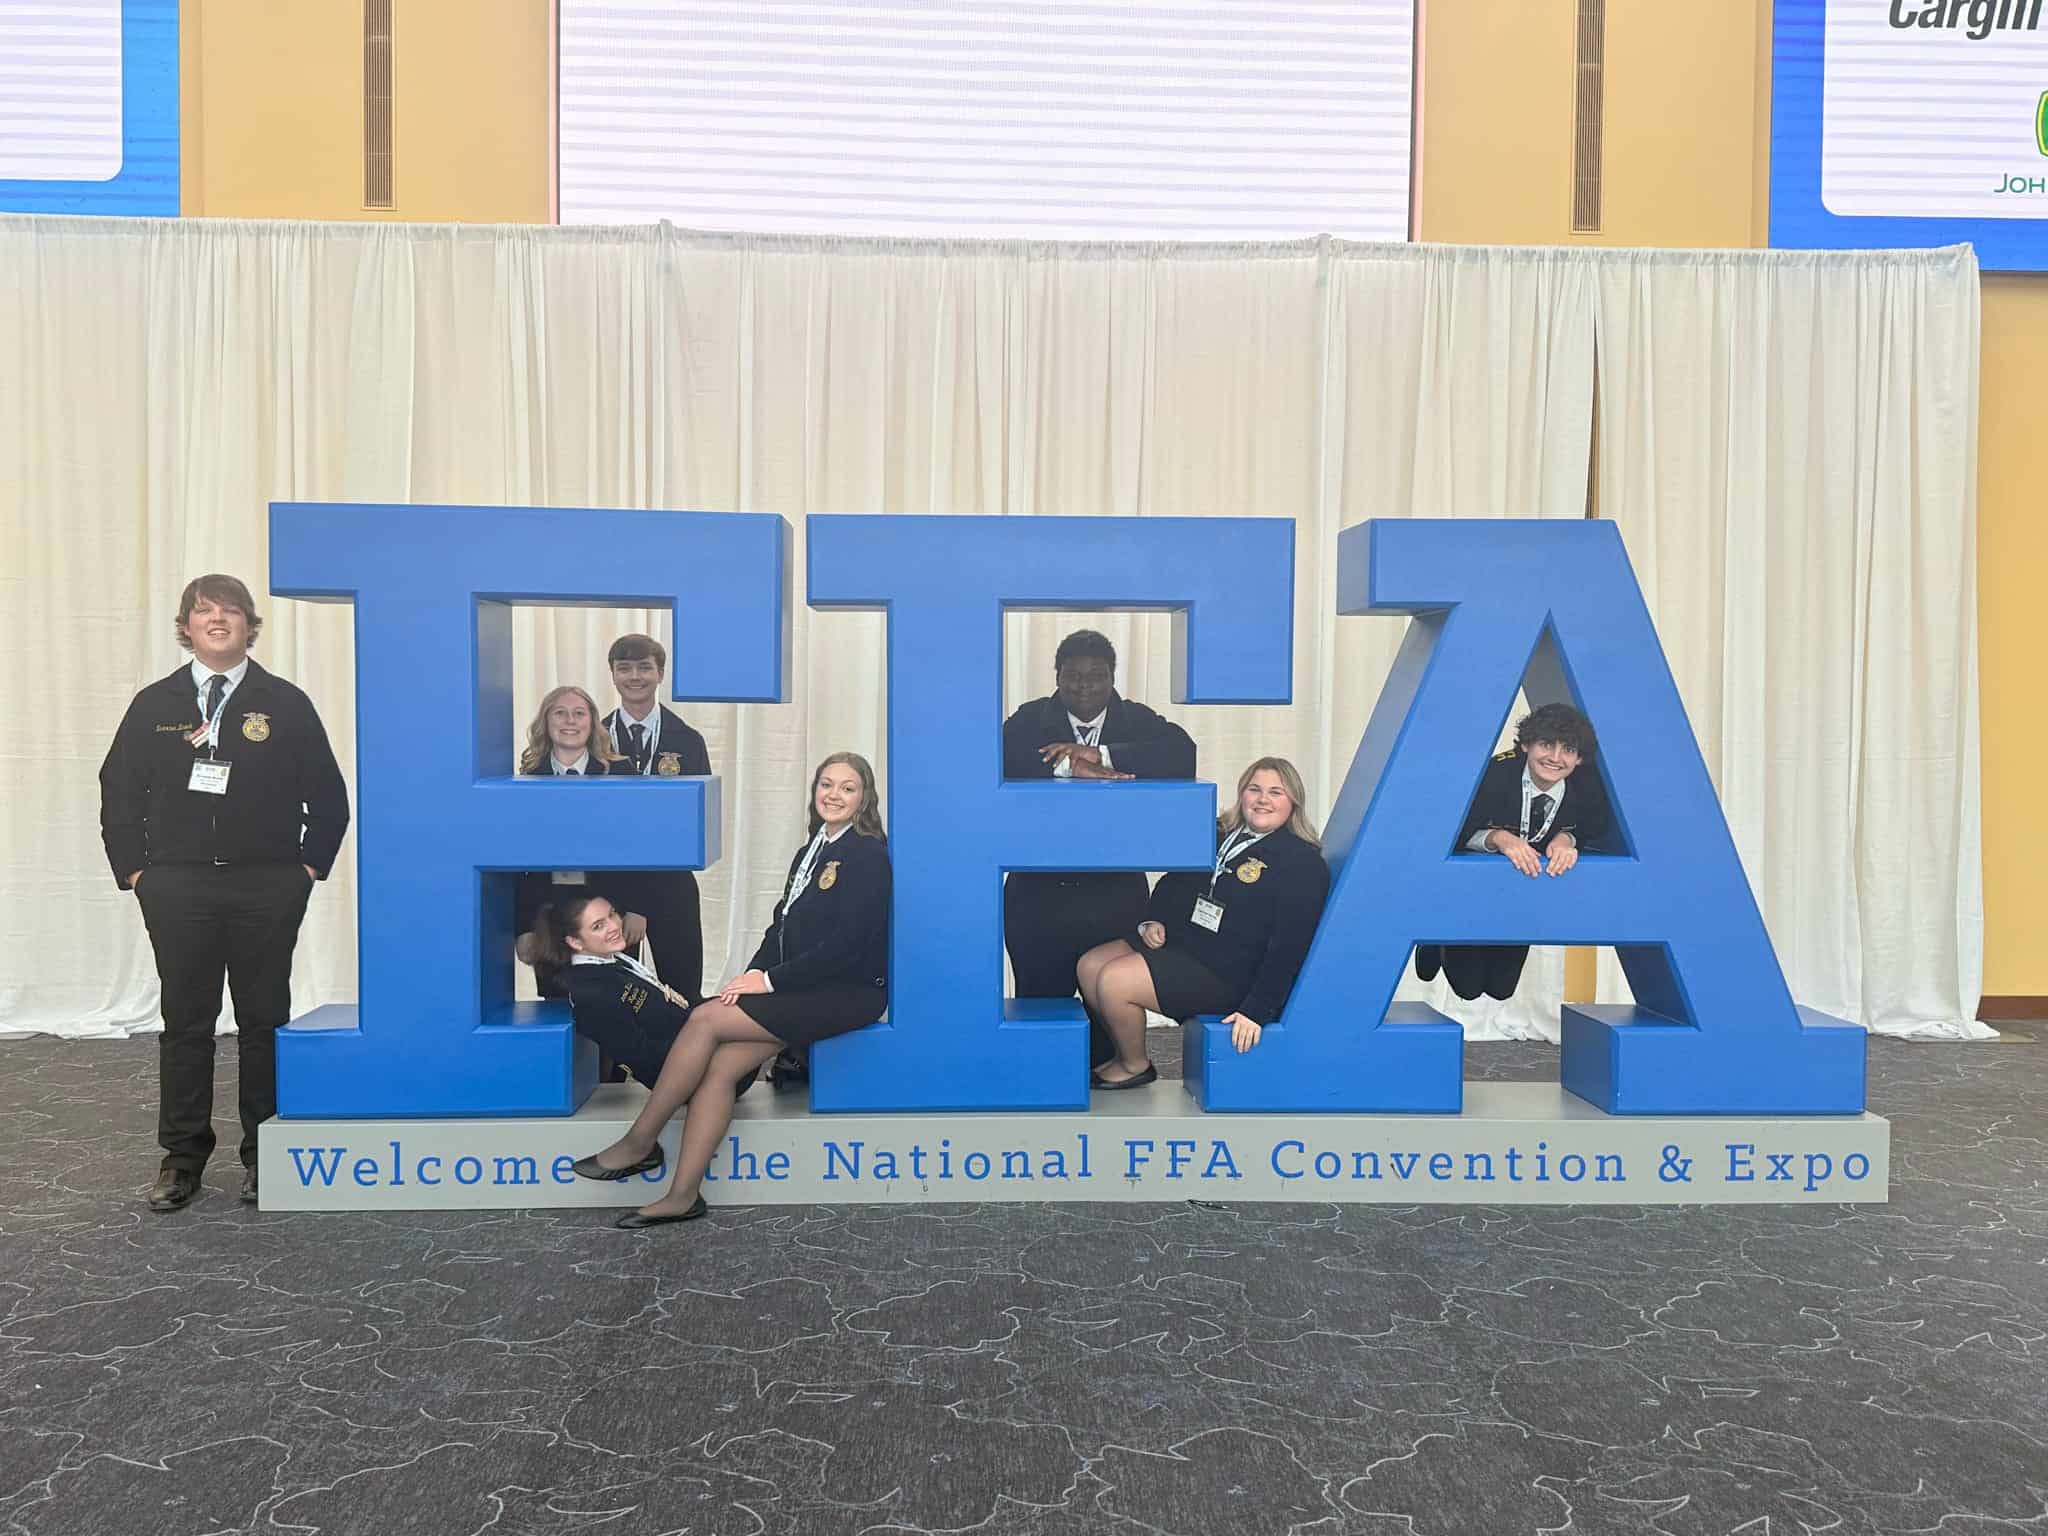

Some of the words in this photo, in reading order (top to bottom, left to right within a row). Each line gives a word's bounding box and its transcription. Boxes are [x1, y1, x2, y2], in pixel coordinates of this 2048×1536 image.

[1889, 0, 2042, 40] Cargill
[269, 502, 1869, 1118] FFA
[287, 1141, 576, 1187] Welcome
[613, 1160, 667, 1184] o
[823, 1134, 1092, 1180] National
[1124, 1140, 1242, 1179] FFA
[1271, 1140, 1626, 1182] Convention
[1658, 1145, 1692, 1183] &
[1725, 1144, 1870, 1192] Expo
